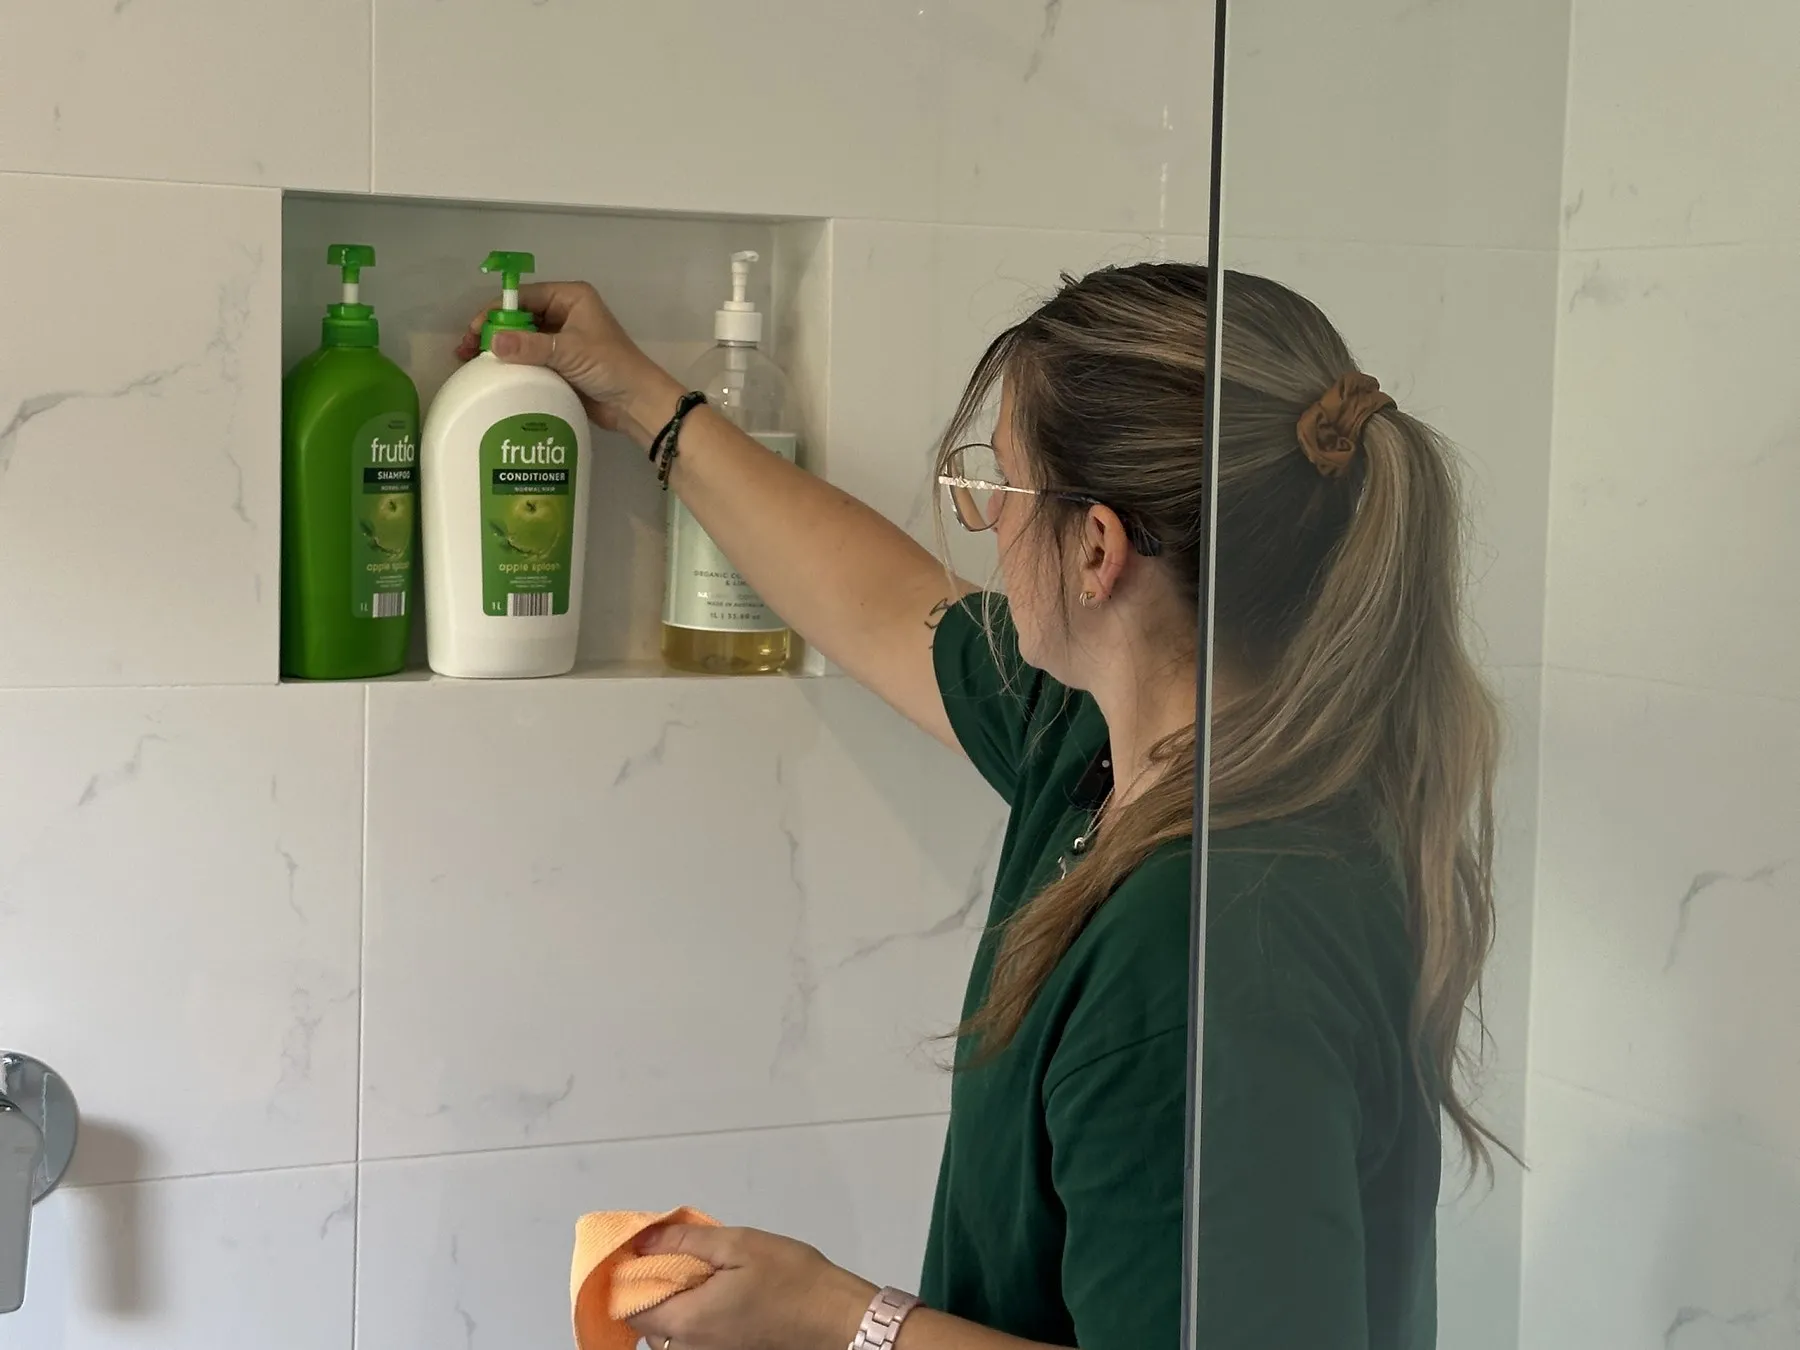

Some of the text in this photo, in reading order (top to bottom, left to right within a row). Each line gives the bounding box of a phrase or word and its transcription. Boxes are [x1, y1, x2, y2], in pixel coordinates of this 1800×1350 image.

[377, 470, 411, 480] SHAMPOO
[499, 472, 566, 481] CONDITIONER
[499, 563, 529, 574] apple
[693, 570, 728, 579] ORGANIC
